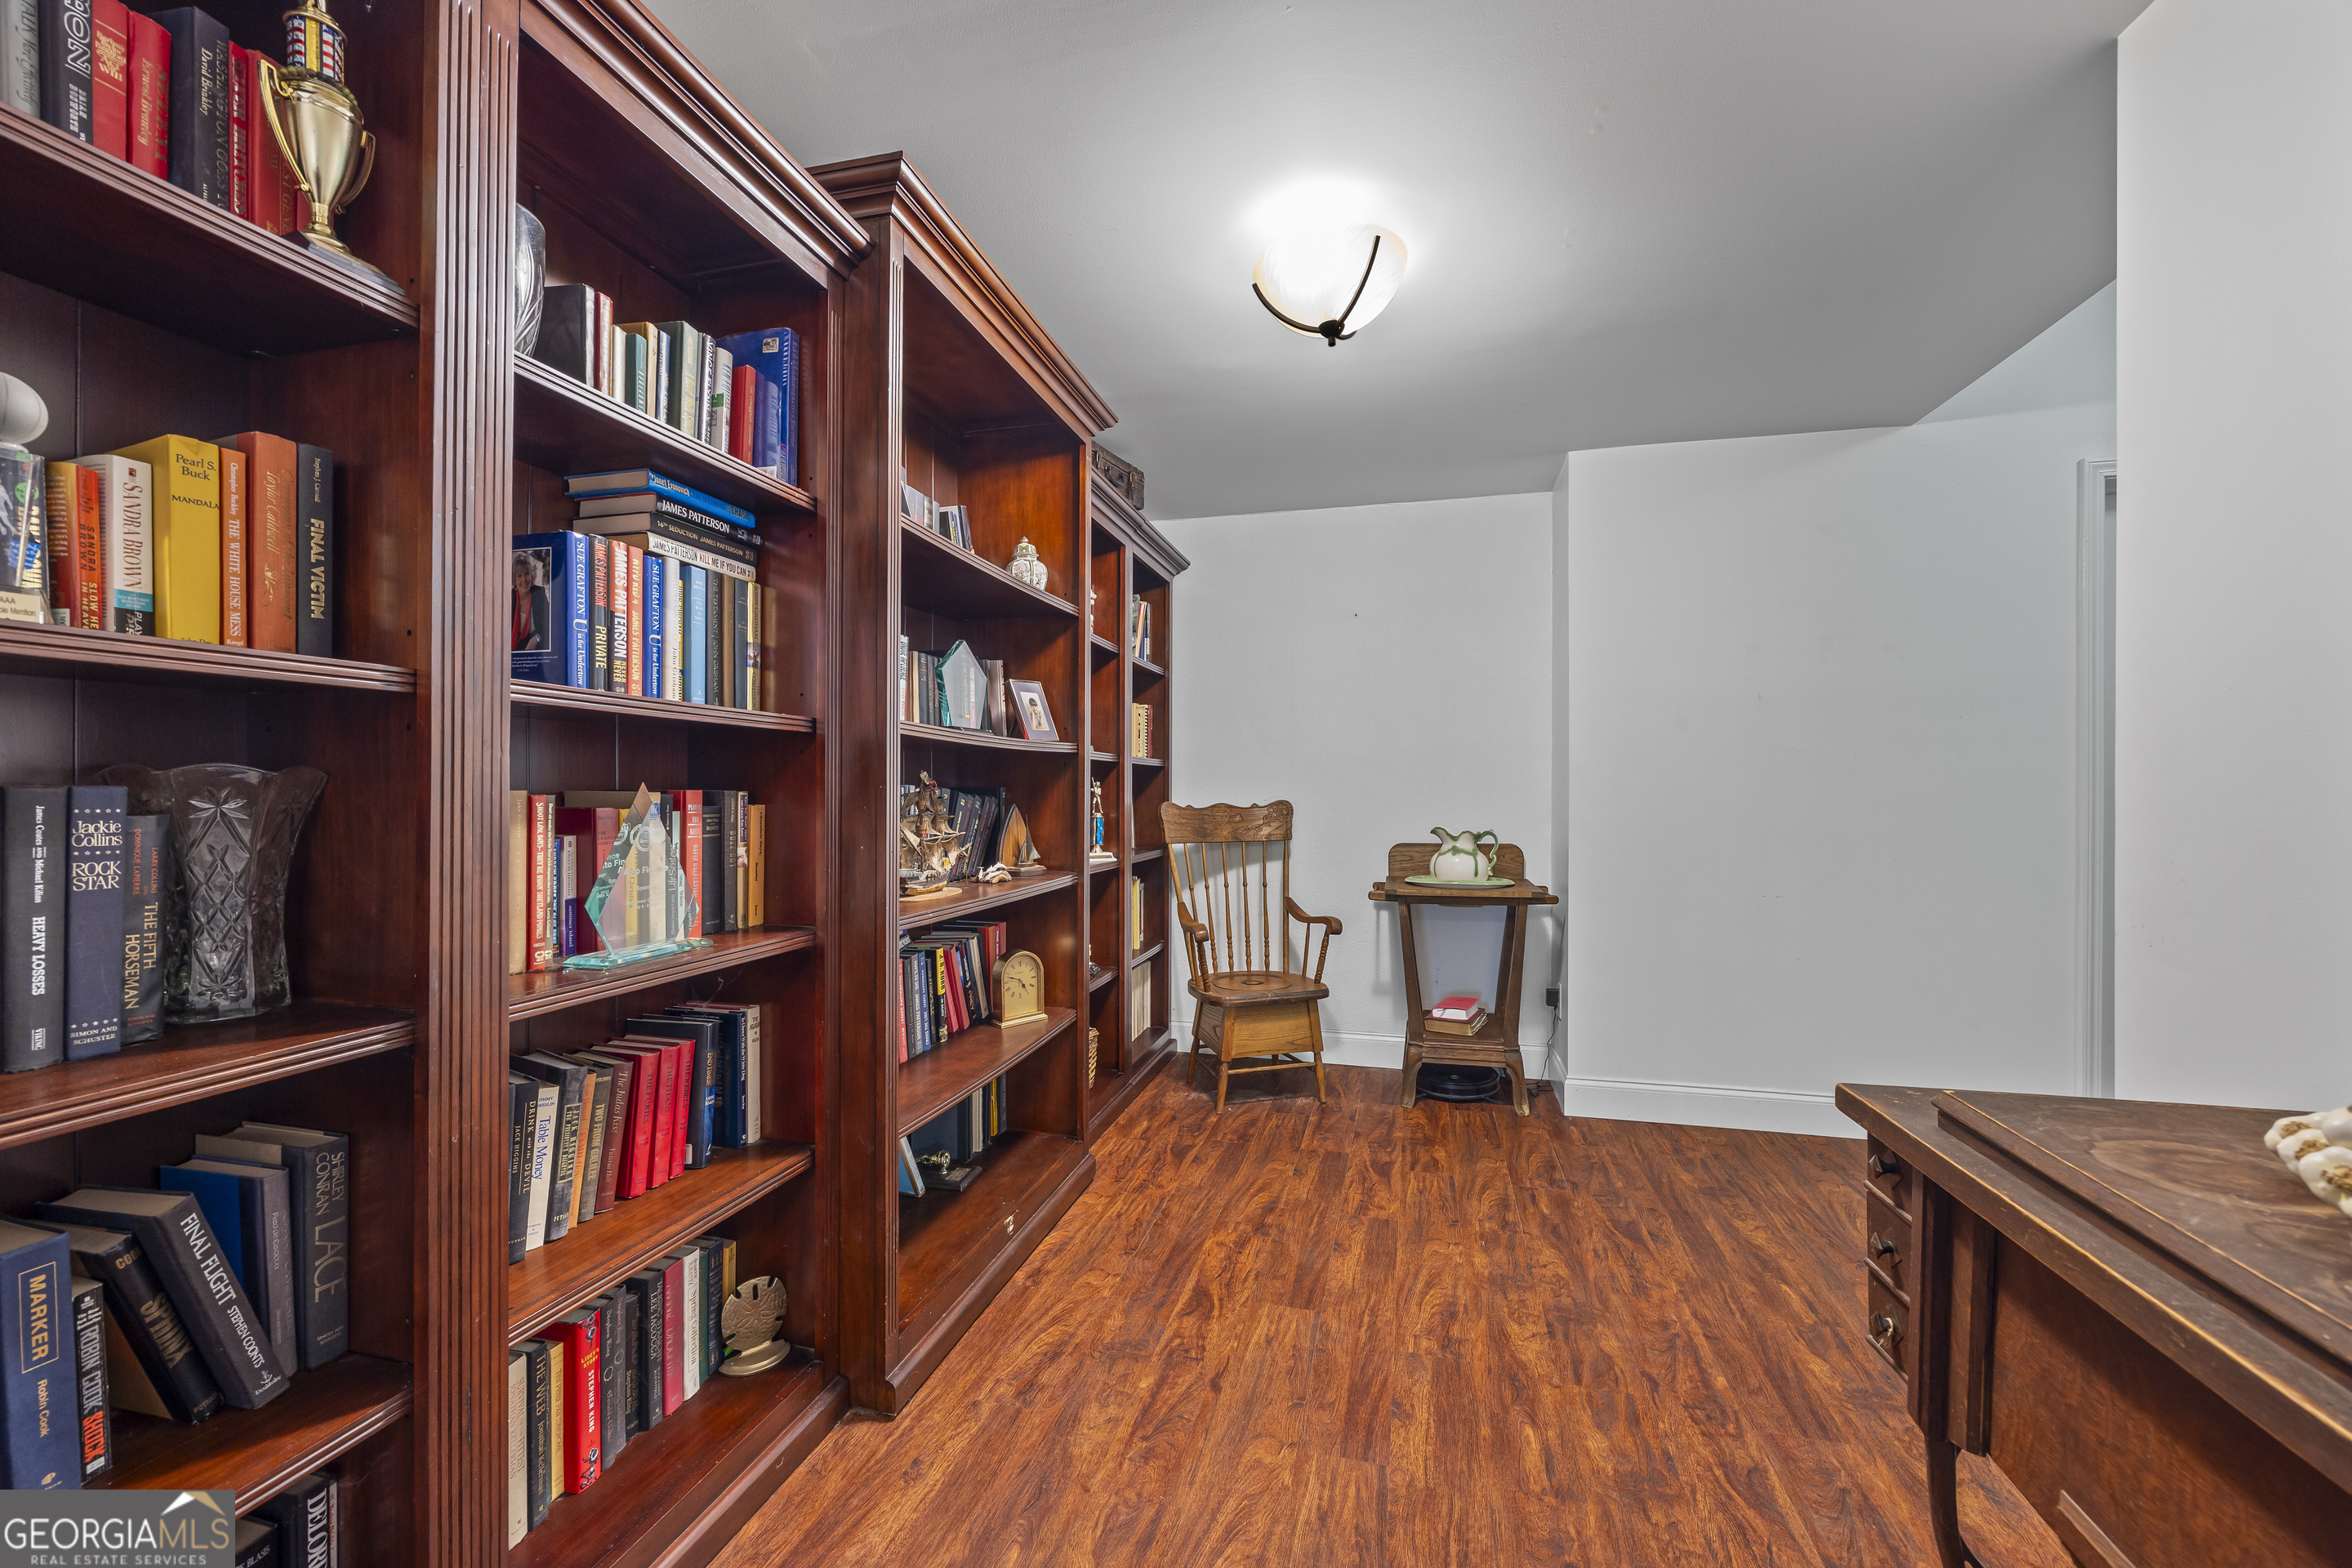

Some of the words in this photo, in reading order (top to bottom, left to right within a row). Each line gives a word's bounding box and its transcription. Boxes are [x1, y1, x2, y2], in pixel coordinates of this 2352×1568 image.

[141, 57, 154, 100] Ernest
[201, 47, 213, 78] David
[69, 83, 79, 132] BOSWORTH
[199, 76, 213, 116] Brinkley
[216, 39, 229, 147] WASHINGTON
[137, 98, 152, 146] Brawley
[216, 148, 229, 190] GOES
[706, 341, 715, 375] VINCE
[706, 377, 715, 412] FLYNN
[175, 453, 205, 470] Pearl
[207, 461, 216, 472] S.
[181, 466, 211, 481] Buck
[229, 462, 238, 492] Christopher
[172, 494, 220, 510] MANDALA
[266, 470, 279, 504] Taylor
[653, 474, 667, 486] Janet
[667, 479, 690, 497] Evanovich
[731, 506, 749, 521] CHASE
[122, 482, 144, 536] SANDRA
[229, 492, 239, 516] Buckley
[662, 499, 688, 519] JAMES
[688, 510, 730, 533] PATTERSON
[229, 519, 240, 540] THE
[266, 505, 280, 555] Caldwell
[310, 518, 325, 564] FINAL
[668, 524, 698, 540] SEDUCTION
[700, 536, 717, 546] JAMES
[717, 541, 743, 556] PATTERSON
[79, 523, 88, 572] BROWN
[87, 525, 96, 572] SANDRA
[122, 537, 144, 590] BROWN
[229, 542, 240, 574] WHITE
[576, 541, 586, 563] SUE
[653, 536, 670, 552] JAMES
[670, 541, 697, 562] PATTERSON
[699, 553, 710, 565] KILL
[711, 557, 719, 568] ME
[725, 561, 736, 573] YOU
[736, 564, 746, 577] CAN
[614, 546, 627, 587] JAMES
[229, 577, 241, 609] HOUSE
[310, 566, 325, 620] VICTIM
[576, 564, 586, 616] GRAFTON
[595, 568, 607, 610] PATTERSON
[10, 607, 37, 617] Mention
[613, 589, 627, 659] PATTERSON
[652, 585, 660, 631] GRAFTON
[229, 612, 241, 637] MESS
[572, 618, 588, 633] U
[226, 638, 244, 647] Knopf
[595, 625, 607, 670] PRIVATE
[577, 649, 585, 686] Undertow
[613, 660, 621, 682] NEVER
[631, 638, 641, 681] PATTERSON
[652, 662, 660, 696] Undertow
[35, 805, 45, 824] James
[72, 820, 122, 834] Jackie
[536, 802, 545, 822] SHOOT
[35, 825, 45, 846] Coates
[71, 833, 122, 847] Collins
[133, 828, 141, 864] DOMINIQUE
[36, 847, 44, 858] AND
[71, 860, 122, 877] ROCK
[34, 859, 45, 884] Michael
[72, 875, 120, 892] STAR
[132, 865, 140, 895] LAPIERRE
[150, 868, 158, 894] COLLINS
[642, 865, 669, 874] Finance
[668, 876, 676, 891] Life
[34, 884, 43, 903] Kilian
[536, 891, 545, 920] SHETLAND
[144, 902, 158, 929] THE
[536, 920, 544, 939] PONIES
[32, 915, 46, 952] HEAVY
[143, 932, 158, 969] FIFTH
[31, 954, 46, 996] LOSSES
[124, 933, 140, 1009] HORSEMAN
[34, 1027, 43, 1051] VIKING
[70, 1029, 100, 1038] SIMON
[101, 1026, 118, 1034] AND
[73, 1033, 116, 1045] SCHUSTER
[617, 1071, 628, 1088] The
[682, 1078, 690, 1109] REBELS
[595, 1103, 605, 1121] TWO
[614, 1088, 626, 1114] Judas
[643, 1089, 652, 1125] FURIES
[664, 1082, 673, 1114] TITANS
[528, 1100, 537, 1133] DRINK
[537, 1116, 551, 1143] Table
[612, 1115, 622, 1134] Kiss
[592, 1124, 604, 1147] FROM
[512, 1143, 520, 1174] HIGGINS
[531, 1145, 548, 1180] Money
[567, 1135, 577, 1178] HIGGINS
[587, 1149, 599, 1181] GALILEE
[316, 1152, 330, 1216] CONRAN
[332, 1152, 345, 1201] SHIRLEY
[523, 1164, 532, 1194] DEVIL
[314, 1215, 346, 1303] LACE
[180, 1212, 212, 1259] FINAL
[201, 1254, 238, 1305] FLIGHT
[227, 1305, 251, 1340] STEPHEN
[243, 1335, 265, 1368] COONTS
[689, 1290, 698, 1321] Spring
[29, 1274, 49, 1362] MARKER
[79, 1324, 100, 1372] ROBIN
[581, 1348, 600, 1364] LISEY'S
[583, 1356, 599, 1369] STORY
[536, 1351, 546, 1383] THE
[38, 1379, 48, 1410] Robin
[82, 1370, 103, 1415] COOK
[516, 1377, 525, 1420] SURVIVAL
[536, 1384, 546, 1416] WEB
[38, 1410, 50, 1438] Cook
[82, 1410, 105, 1463] SHOCK
[537, 1456, 546, 1495] Kellerman
